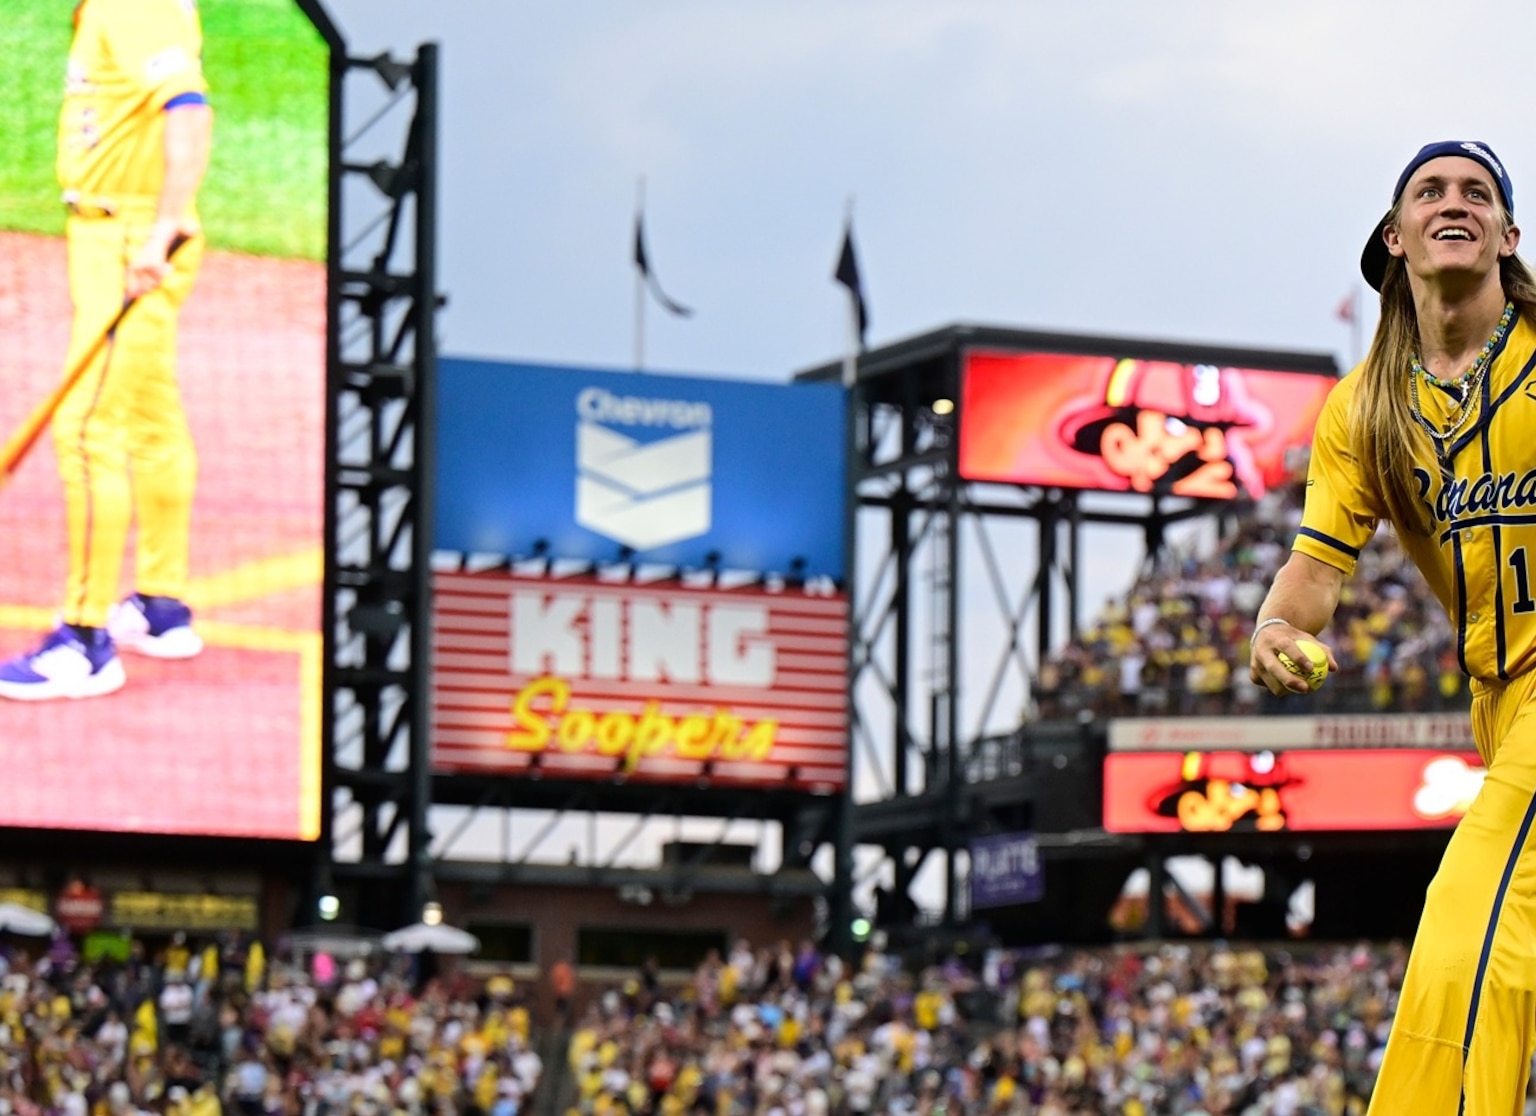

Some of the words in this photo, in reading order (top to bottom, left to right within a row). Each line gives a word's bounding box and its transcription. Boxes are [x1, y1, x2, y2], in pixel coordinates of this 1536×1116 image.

[576, 387, 713, 430] Chevron
[512, 589, 776, 688] KING
[505, 676, 781, 776] Soopers
